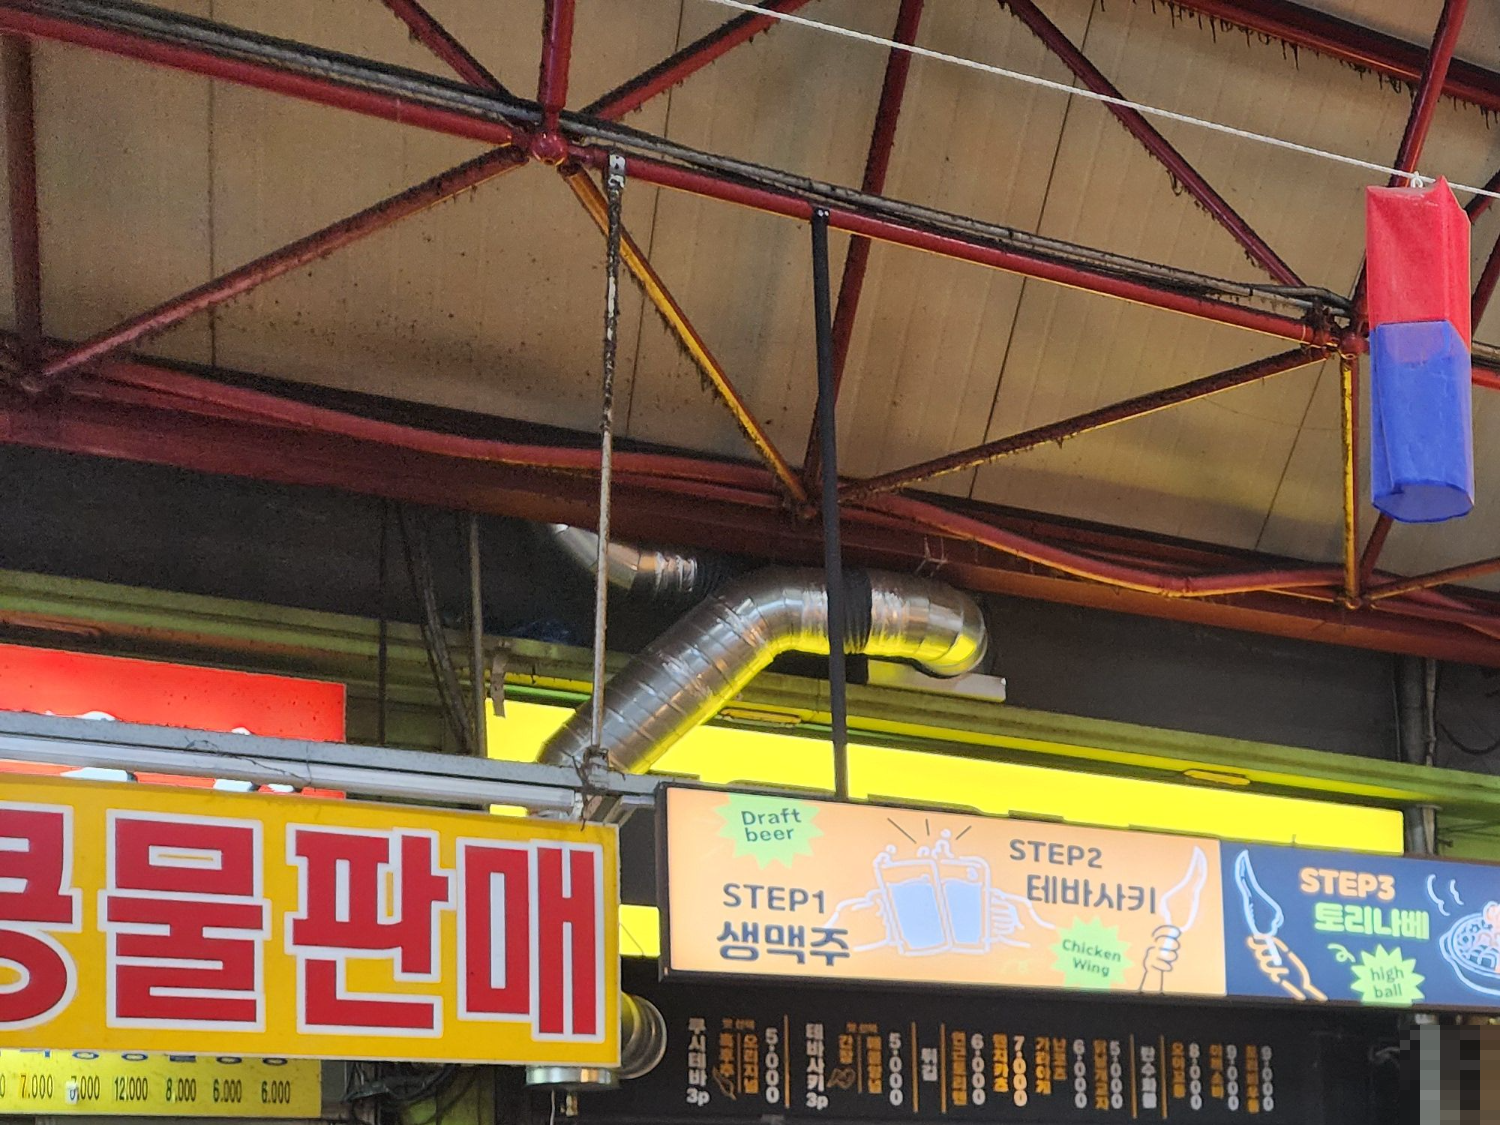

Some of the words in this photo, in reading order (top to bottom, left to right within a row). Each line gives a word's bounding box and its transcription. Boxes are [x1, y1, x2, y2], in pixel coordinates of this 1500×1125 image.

[741, 808, 802, 825] Draft
[745, 827, 794, 842] beer
[1009, 838, 1103, 869] STEP2
[1026, 874, 1156, 914] 테바사키
[1300, 867, 1395, 901] STEP3
[723, 883, 825, 914] STEP1
[1314, 901, 1430, 940] 토리나베
[716, 921, 850, 966] 생맥주
[1062, 939, 1121, 962] Chicken
[1072, 957, 1110, 977] Wing
[1370, 966, 1404, 983] high
[1373, 983, 1403, 998] ball
[686, 1088, 709, 1106] 3p
[806, 1093, 828, 1110] 3p
